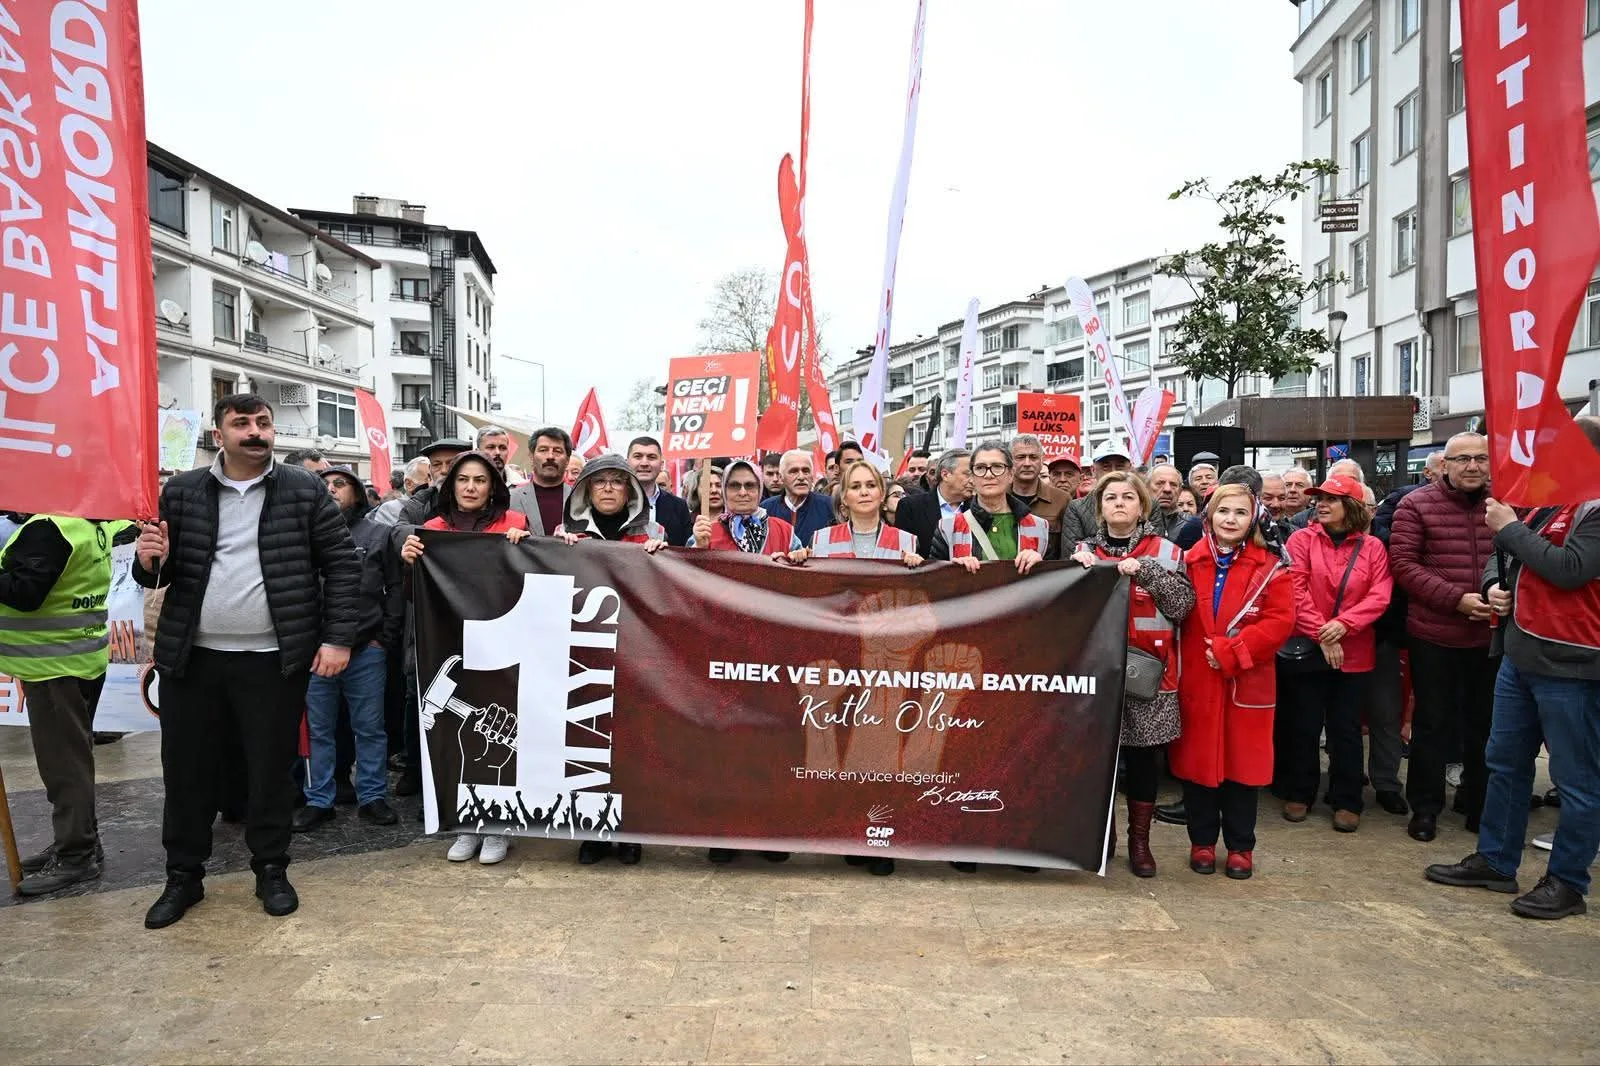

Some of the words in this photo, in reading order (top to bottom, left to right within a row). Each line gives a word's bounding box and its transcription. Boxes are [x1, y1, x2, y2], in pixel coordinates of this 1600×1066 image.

[673, 415, 703, 433] YO
[1022, 411, 1077, 422] SARAYDA
[668, 432, 714, 452] RUZ
[708, 660, 781, 683] EMEK
[786, 665, 821, 685] VE
[827, 668, 976, 694] DAYANIŞMA
[982, 673, 1097, 695] BAYRAMI
[564, 585, 621, 794] MAYIS
[798, 688, 883, 730] Kutlu
[895, 691, 985, 733] Olsun
[790, 767, 837, 780] "Emek
[839, 771, 857, 781] en
[858, 770, 893, 785] yüce
[895, 771, 961, 786] değerdir."
[866, 826, 895, 838] CHP
[867, 839, 890, 847] ORDU
